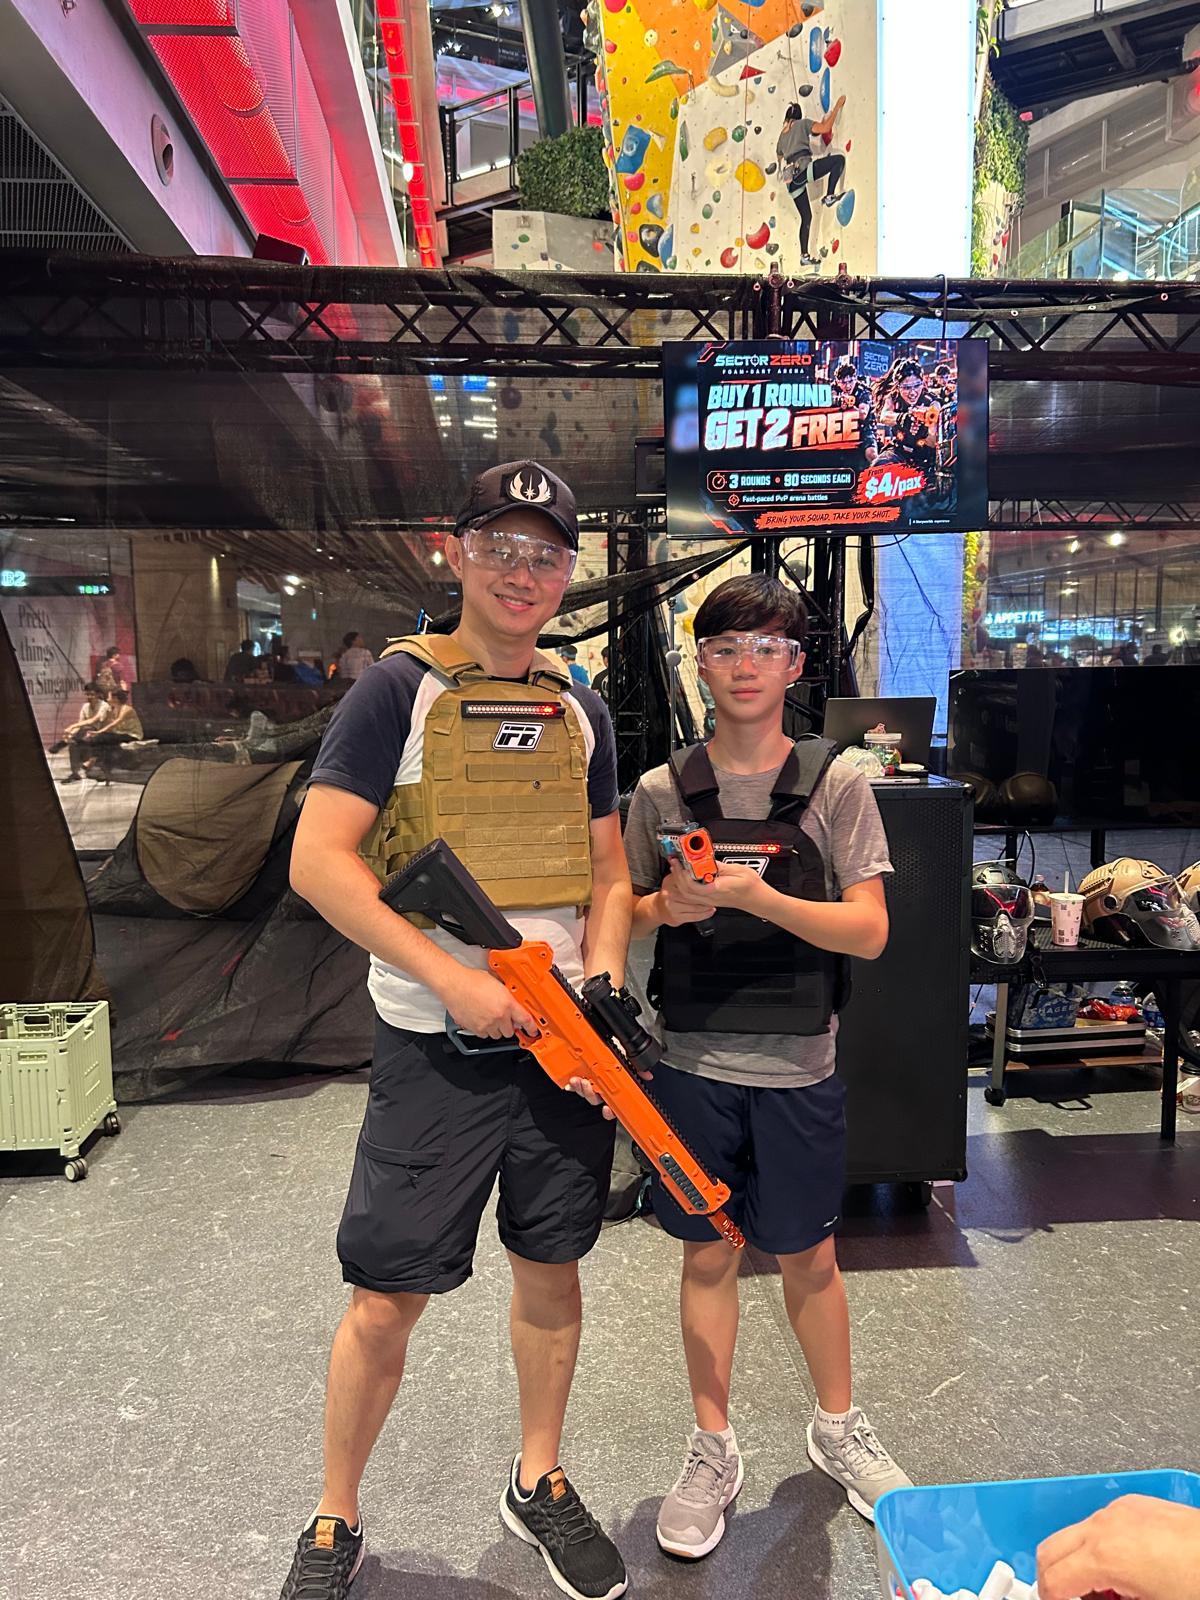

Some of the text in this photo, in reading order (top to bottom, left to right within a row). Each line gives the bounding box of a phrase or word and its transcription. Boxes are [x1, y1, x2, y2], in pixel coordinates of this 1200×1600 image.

[714, 354, 812, 367] SECTOR ZERO
[864, 360, 888, 372] ZERO
[707, 383, 833, 409] BUY 1 ROUND
[704, 407, 860, 451] GET 2 FREE
[868, 468, 884, 477] From
[729, 473, 851, 489] 3 ROUNDS 90 SECONDS EACH
[865, 472, 922, 500] $4/pax
[742, 494, 774, 503] Fast-paced
[775, 494, 789, 502] PvP
[766, 510, 890, 525] BRING YOUR SQUAD. TAKE YOUR SHOT.
[18, 603, 52, 629] Pretty
[994, 611, 1046, 624] APPETITE
[20, 637, 55, 669] things
[36, 671, 85, 701] Singapore
